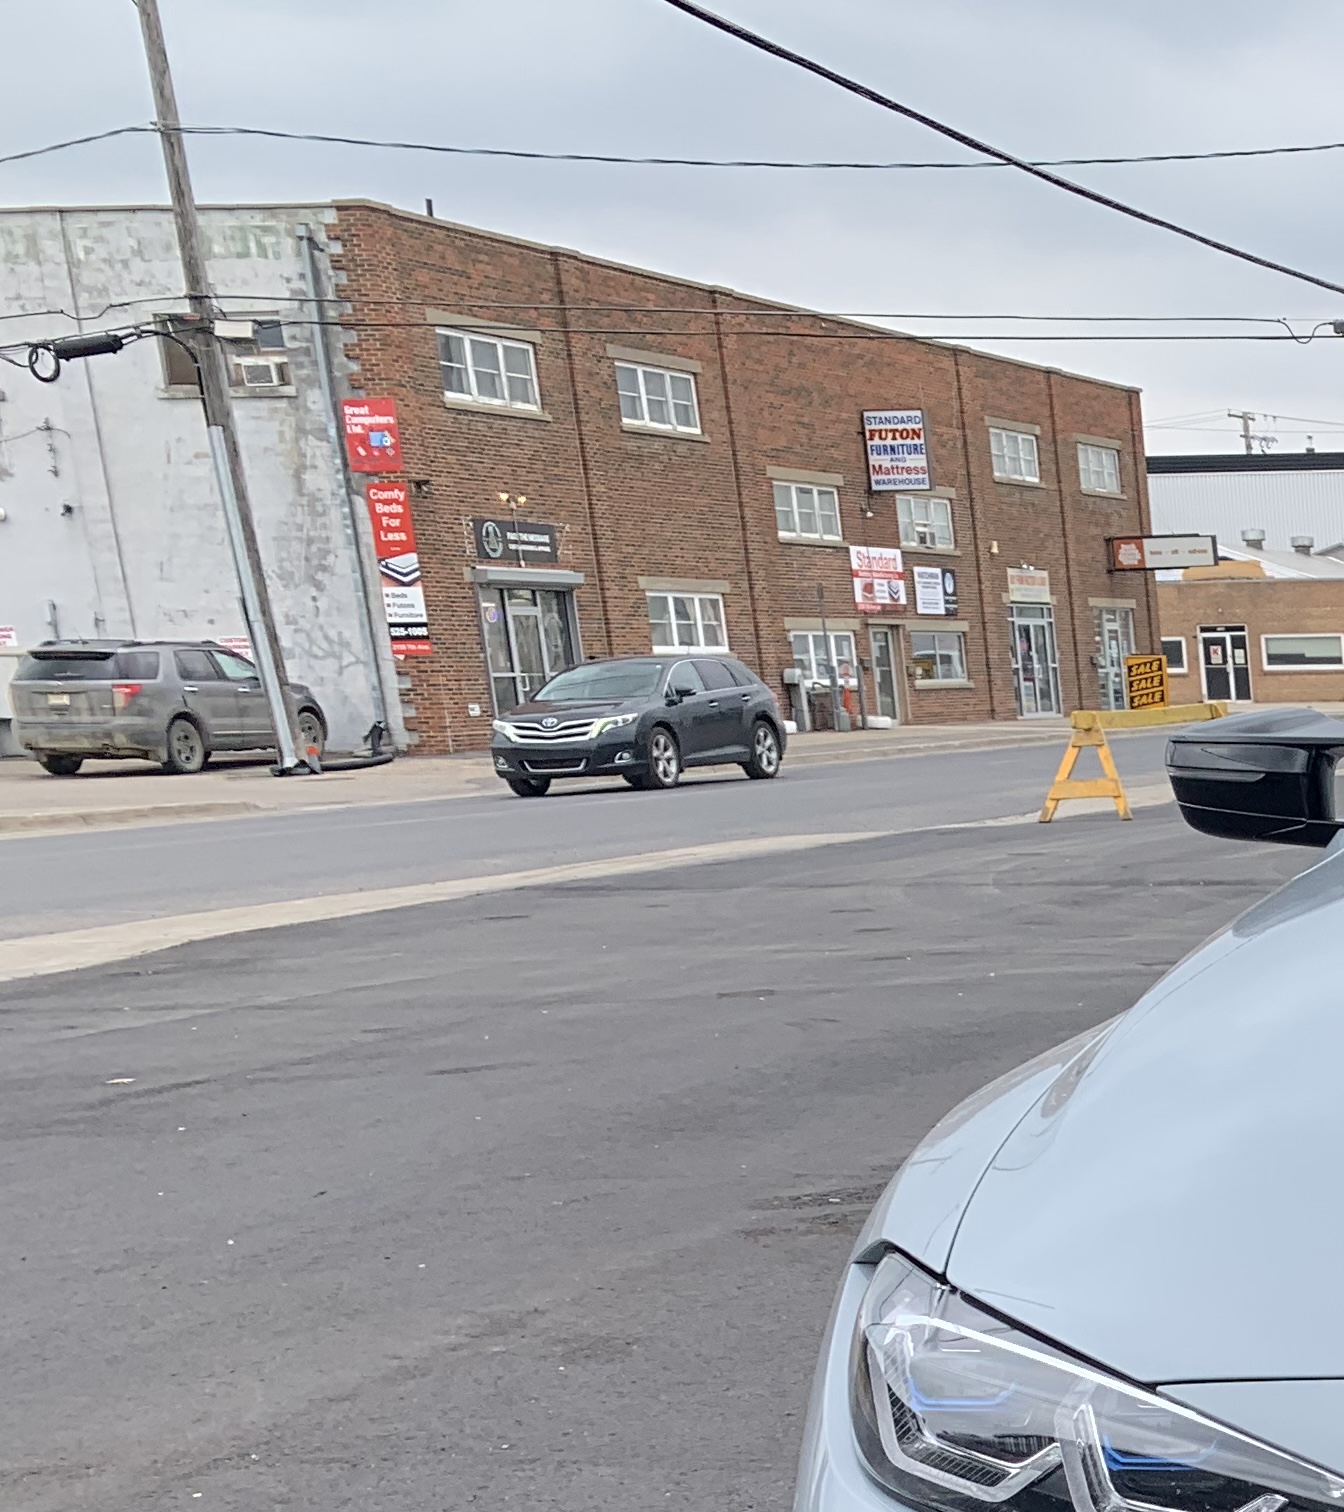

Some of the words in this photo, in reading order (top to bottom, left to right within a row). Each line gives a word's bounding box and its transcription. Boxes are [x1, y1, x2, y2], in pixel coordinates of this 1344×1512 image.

[343, 404, 370, 415] Great
[345, 414, 395, 425] Computers
[865, 415, 922, 426] STANDARD
[867, 428, 922, 441] FUTON
[869, 443, 926, 456] FURNITURE
[872, 463, 928, 476] Mattress
[873, 477, 928, 486] WAREHOUSE
[369, 488, 406, 502] Comfy
[374, 502, 405, 514] Beds
[381, 516, 401, 528] For
[379, 530, 408, 541] Less
[856, 549, 898, 570] Standard
[1130, 660, 1161, 677] SALE
[1131, 675, 1162, 692] SALE
[1132, 691, 1163, 707] SALE
